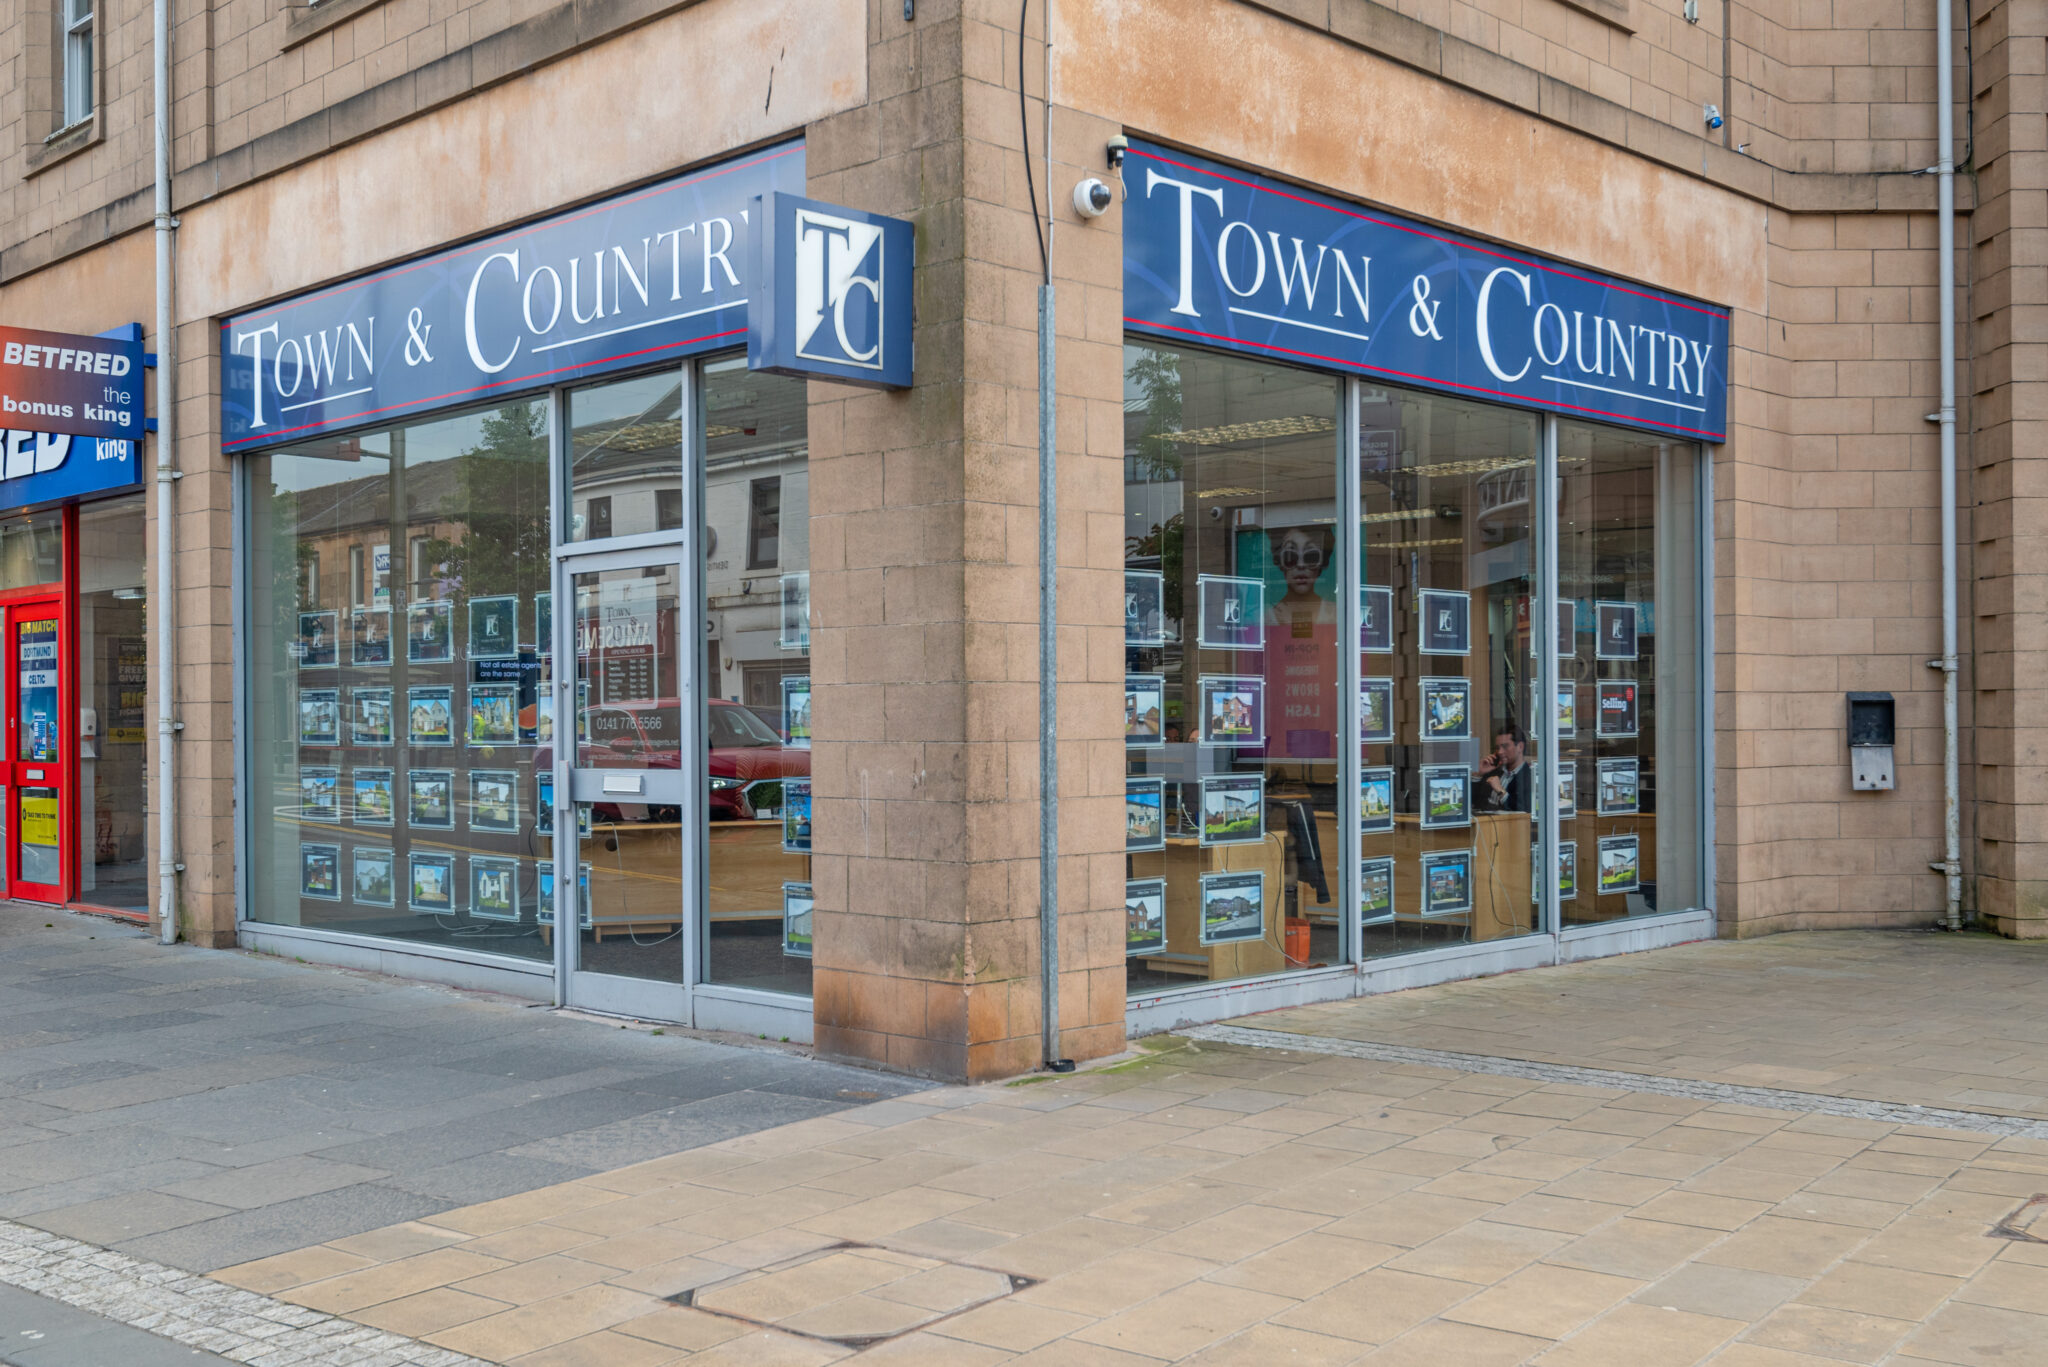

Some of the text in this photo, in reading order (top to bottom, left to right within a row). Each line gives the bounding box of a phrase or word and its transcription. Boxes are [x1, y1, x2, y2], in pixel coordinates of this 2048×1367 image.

[404, 306, 434, 367] &
[465, 210, 749, 374] COUNTR
[1409, 274, 1443, 341] &
[4, 341, 131, 377] BETFRED
[104, 386, 131, 405] the
[3, 395, 131, 427] bonus king
[0, 429, 71, 481] ED
[96, 436, 128, 462] king
[32, 619, 57, 634] MATCH
[28, 674, 46, 685] CELTIC
[1602, 697, 1628, 712] Selling
[597, 716, 618, 730] 0141
[638, 715, 662, 730] 5566
